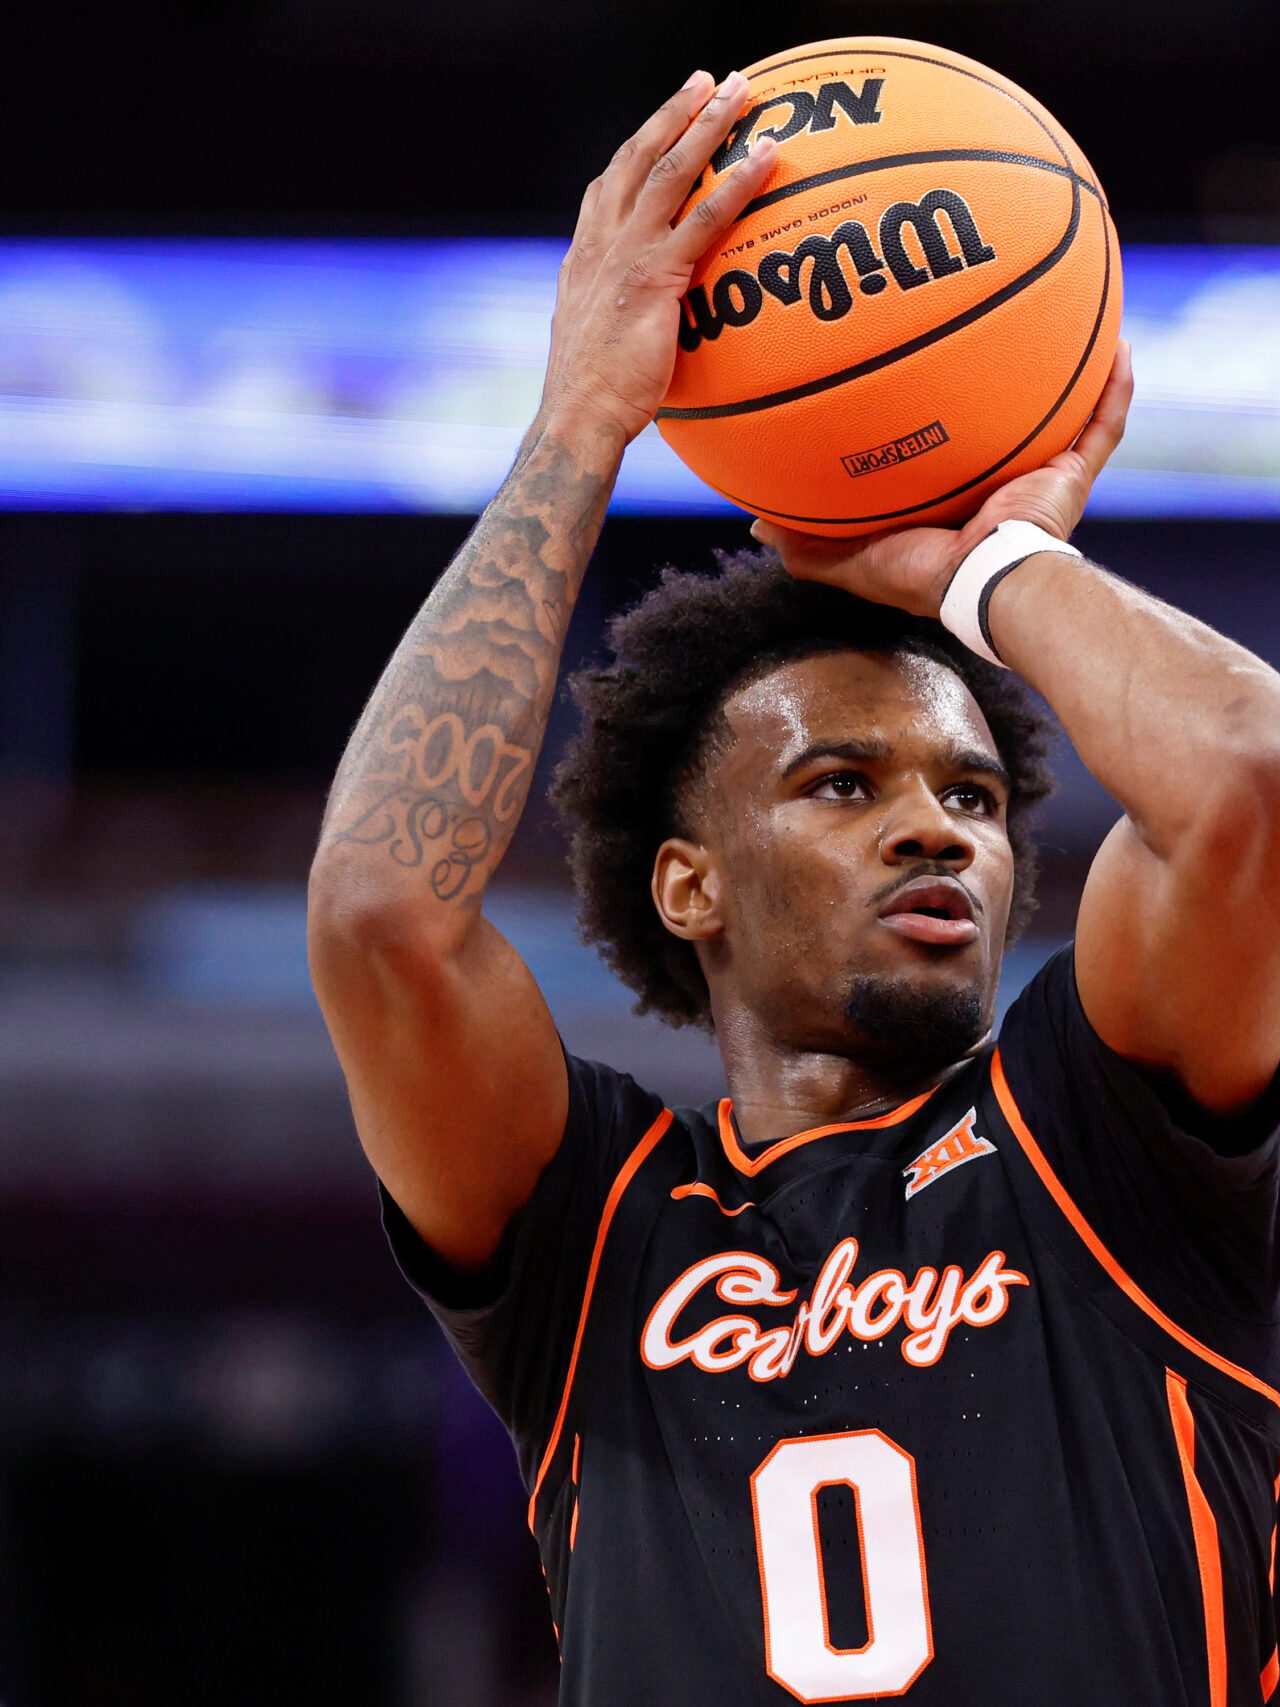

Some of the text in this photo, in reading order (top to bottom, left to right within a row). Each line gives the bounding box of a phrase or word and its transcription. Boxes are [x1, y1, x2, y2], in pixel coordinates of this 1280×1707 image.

[690, 78, 886, 192] NCA
[677, 188, 996, 353] Wilson
[720, 193, 868, 260] INDOOR GAME BALL
[902, 1108, 994, 1198] XII
[640, 1236, 1030, 1383] Cowboys
[750, 1427, 935, 1705] 0
